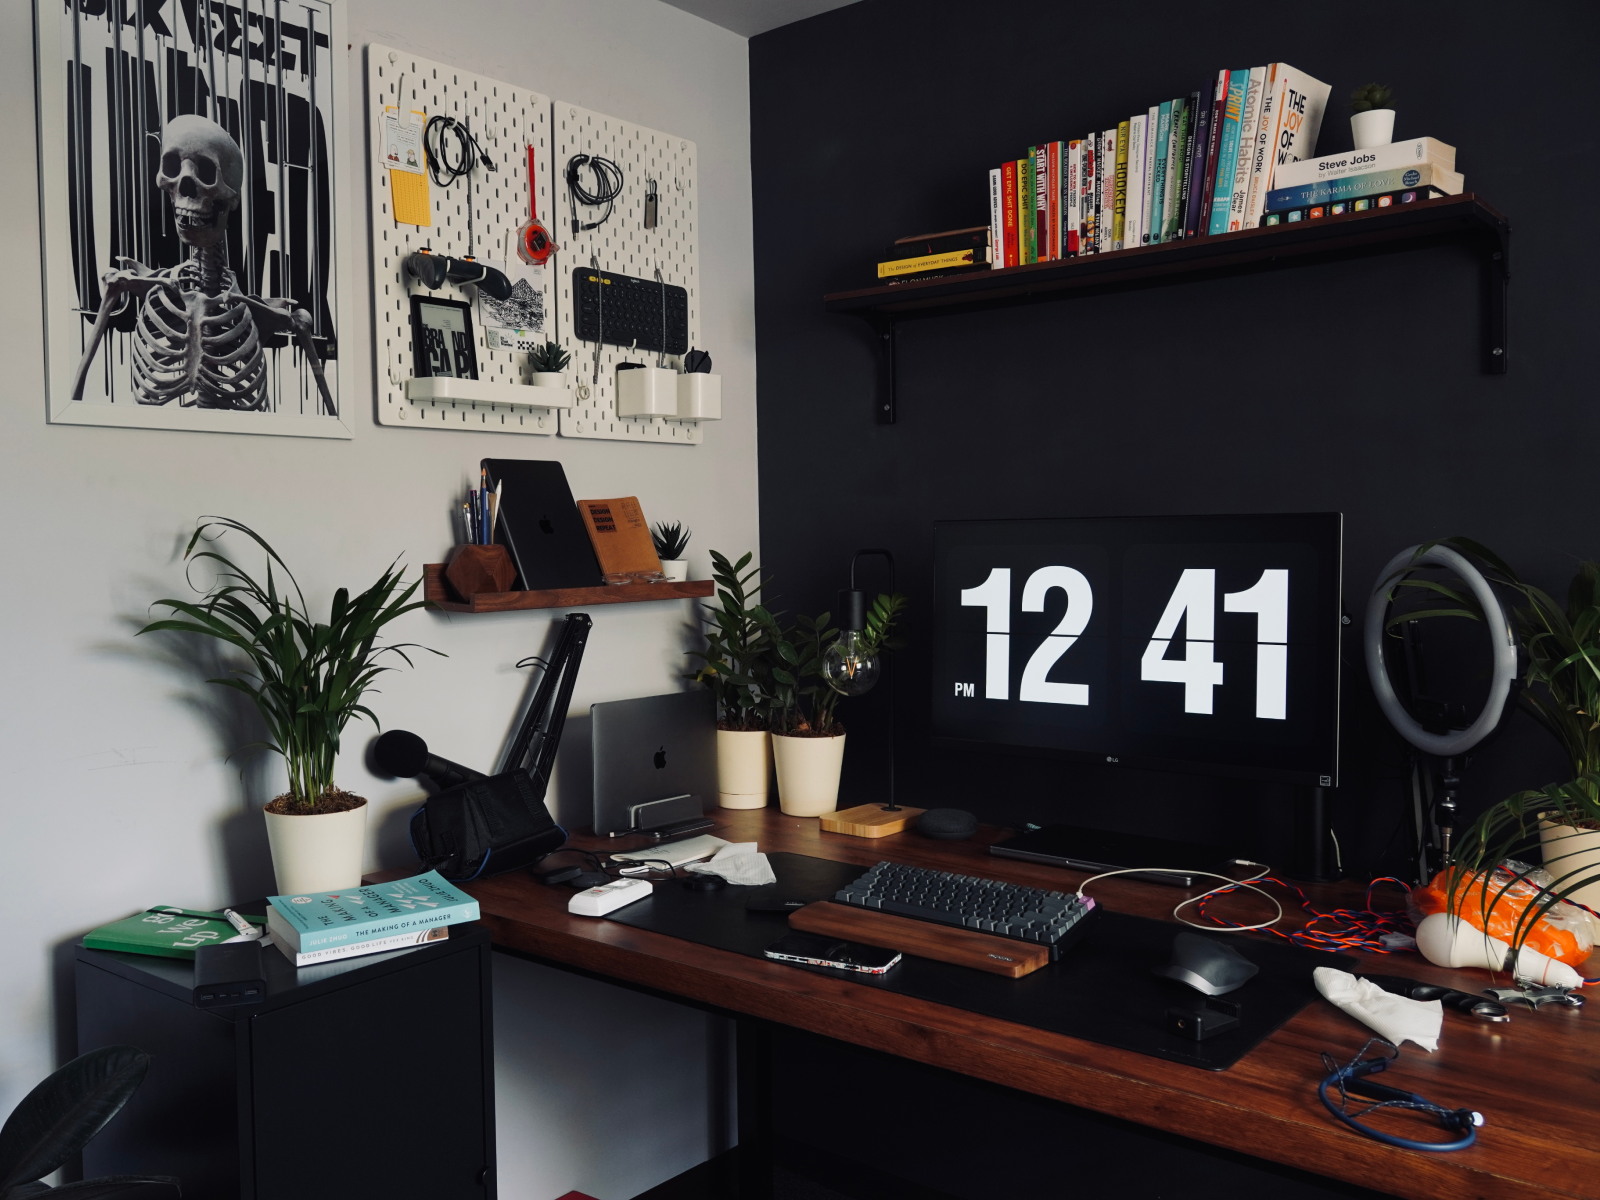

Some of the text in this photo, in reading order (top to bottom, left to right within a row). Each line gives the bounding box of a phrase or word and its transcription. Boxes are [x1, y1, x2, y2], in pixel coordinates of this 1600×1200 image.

[1224, 81, 1244, 123] SPRINT
[1263, 96, 1273, 114] THE
[1288, 89, 1307, 115] THE
[1158, 114, 1166, 141] MANSON
[1235, 79, 1262, 184] Atomic Habits
[1261, 115, 1269, 132] JOY
[1283, 110, 1304, 133] JOY
[1170, 110, 1180, 170] CREATIVE CONFIDENCE
[1259, 133, 1267, 146] OF
[1281, 130, 1295, 151] OF
[1021, 163, 1028, 175] DO
[1036, 149, 1045, 172] START
[1255, 147, 1265, 173] WORK
[1318, 153, 1375, 171] Steve Jobs
[1037, 174, 1045, 194] WITH
[1115, 162, 1127, 215] HOOKED
[1181, 163, 1190, 200] STORYTELLING
[1252, 176, 1260, 194] BRUCE
[1300, 190, 1318, 199] THE
[1319, 185, 1352, 197] KARMA
[1353, 182, 1366, 191] OF
[1367, 177, 1394, 189] LOVE
[1037, 193, 1045, 211] WHY
[1231, 192, 1239, 212] Clear
[1237, 190, 1246, 214] James
[961, 565, 1289, 720] 12 41
[954, 682, 975, 698] PM
[320, 898, 357, 921] MAKING
[359, 887, 402, 913] MANAGER
[317, 915, 334, 926] THE
[365, 910, 379, 918] OF
[156, 918, 209, 934] we
[355, 929, 369, 937] THE
[371, 924, 399, 934] MAKING
[418, 913, 452, 925] MANAGER
[172, 930, 221, 947] up
[309, 934, 348, 946] JULIE ZHUO
[301, 951, 322, 960] GOOD
[350, 943, 370, 951] GOOD
[371, 940, 388, 948] LIFE
